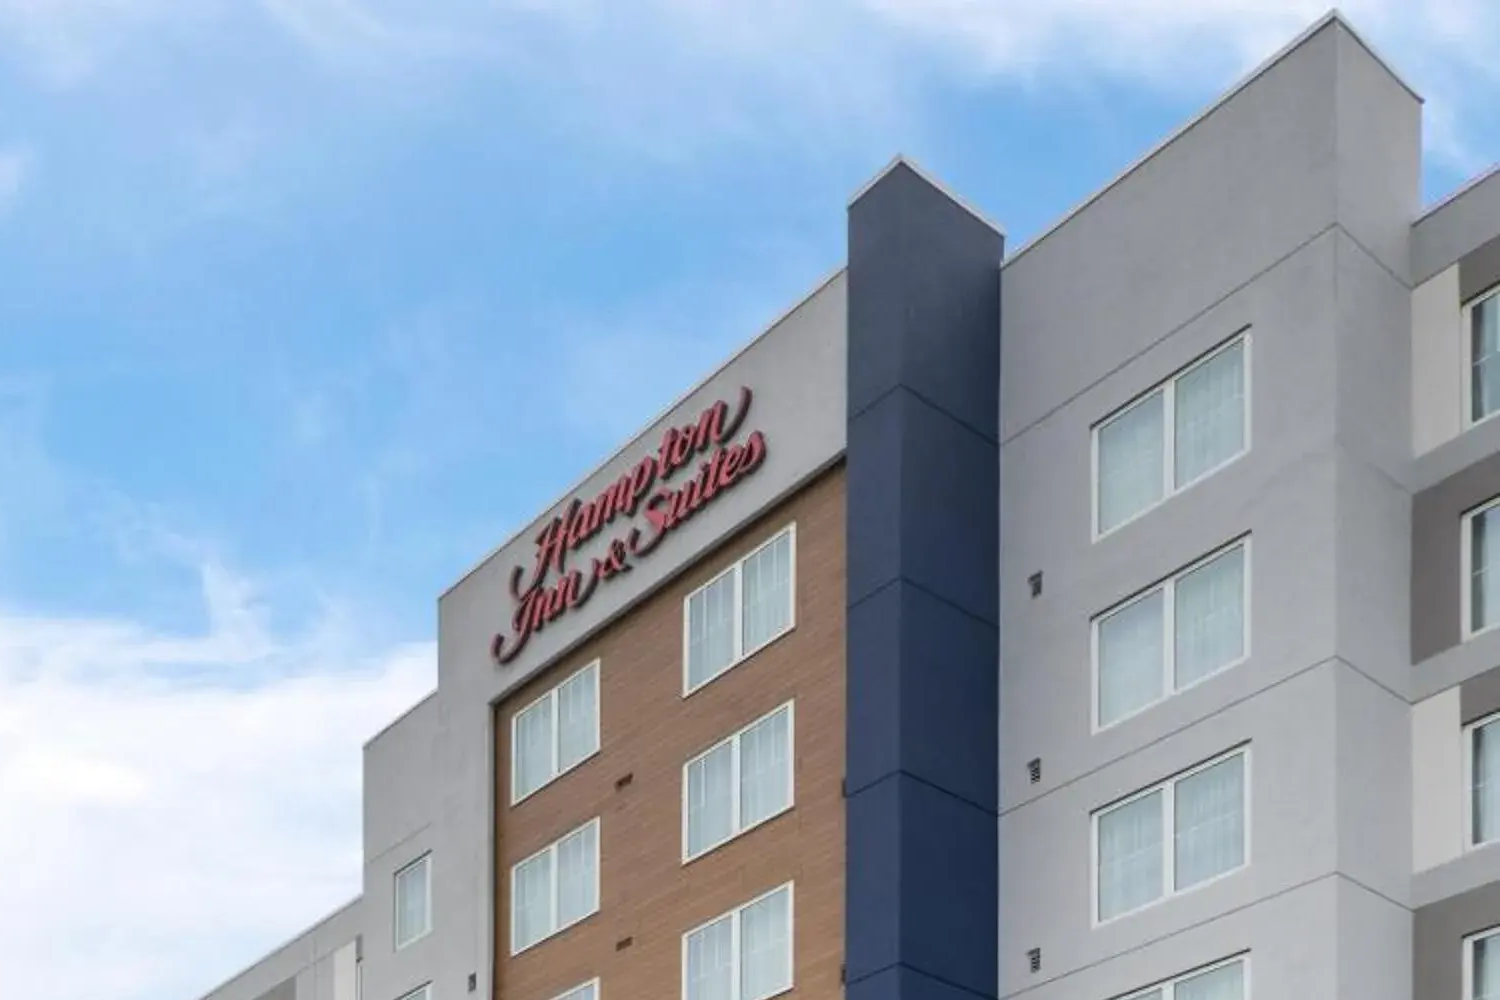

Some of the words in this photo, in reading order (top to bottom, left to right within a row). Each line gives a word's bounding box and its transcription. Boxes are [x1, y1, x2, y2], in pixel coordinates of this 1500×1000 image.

[491, 558, 601, 664] Inn
[628, 430, 766, 558] Suites
[510, 386, 752, 602] Hampton
